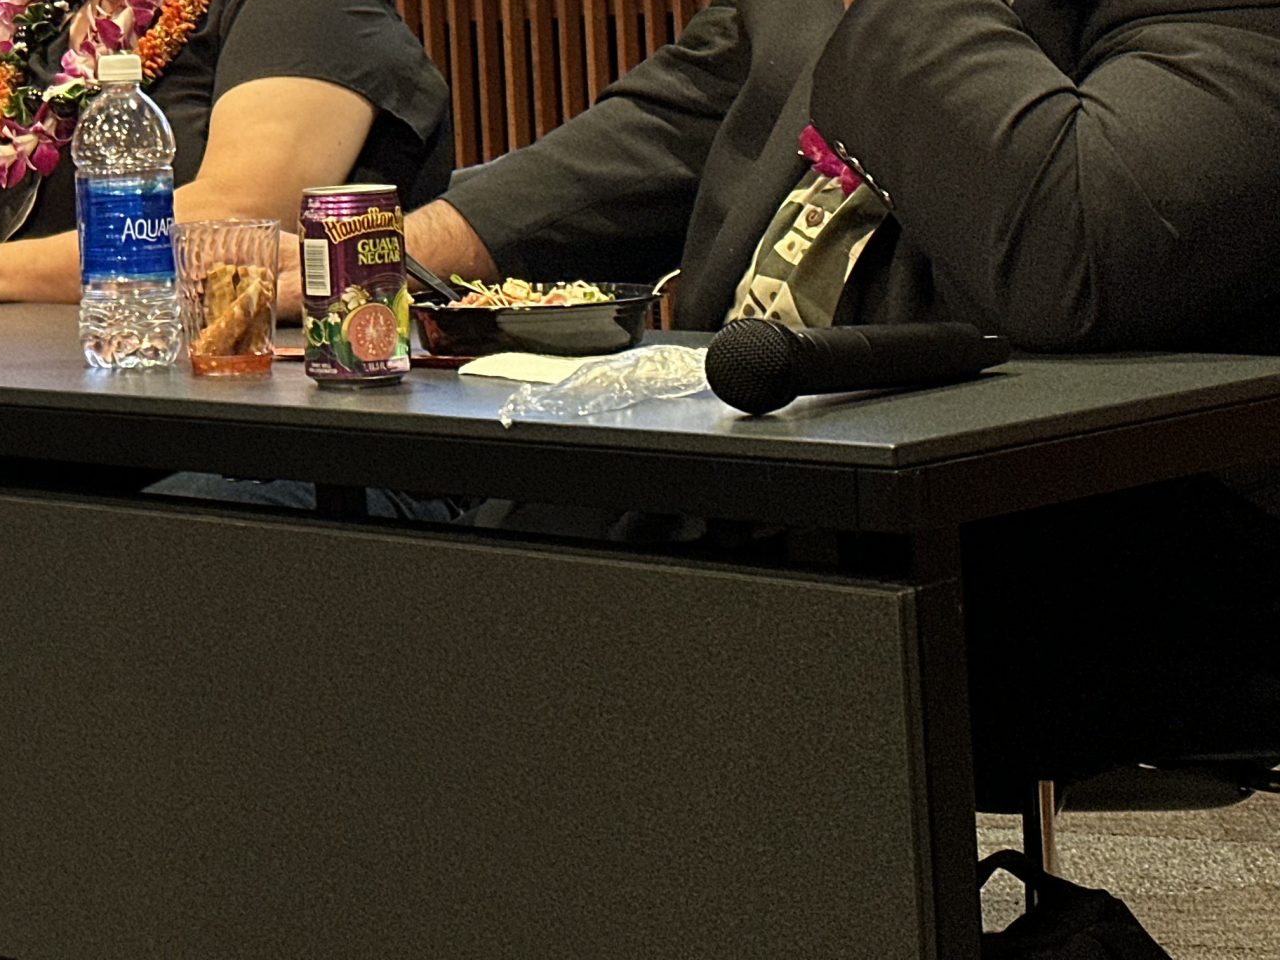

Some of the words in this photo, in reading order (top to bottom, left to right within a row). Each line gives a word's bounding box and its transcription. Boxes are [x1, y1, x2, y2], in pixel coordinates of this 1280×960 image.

[324, 208, 396, 243] Hawaiian
[358, 237, 400, 253] GUAVA
[358, 250, 401, 265] NECTAR
